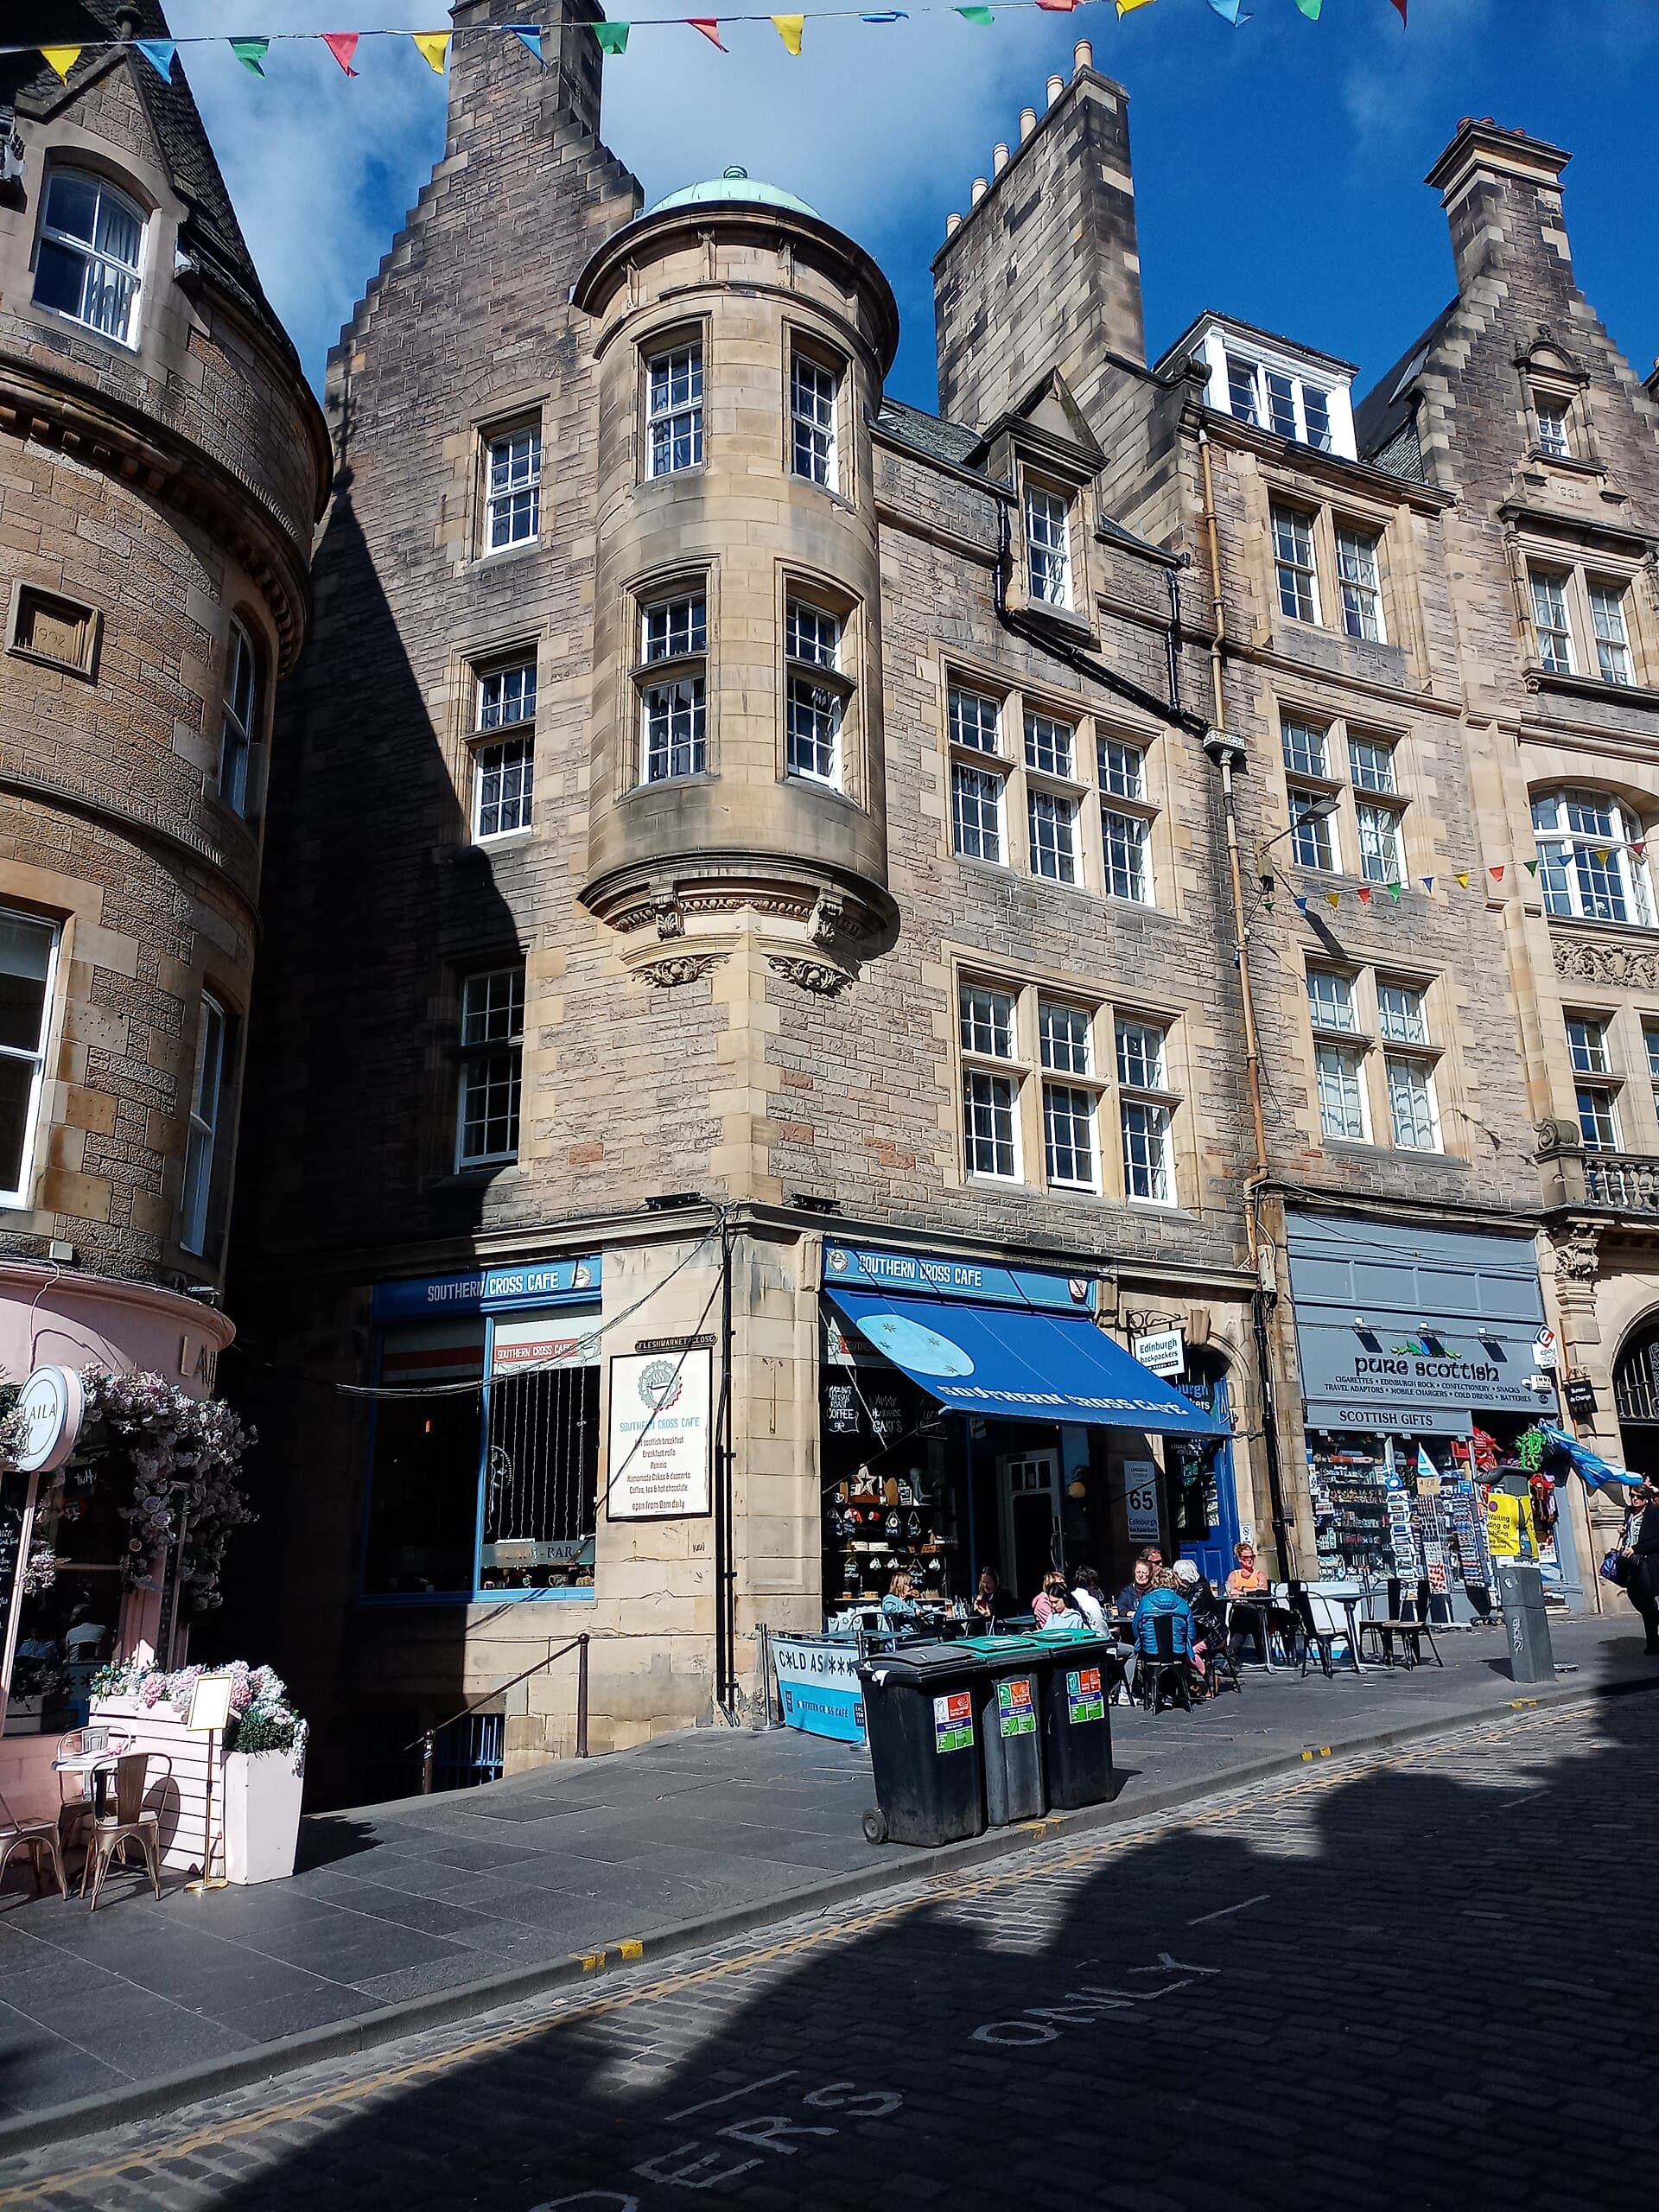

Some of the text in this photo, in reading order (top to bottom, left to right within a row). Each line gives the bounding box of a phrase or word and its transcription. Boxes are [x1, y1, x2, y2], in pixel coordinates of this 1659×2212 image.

[858, 1255, 982, 1287] SOUTHERN CROSS CAFE
[427, 1271, 559, 1302] SOUTHERN CROSS CAFE
[639, 1335, 714, 1349] FLESHMARKET CLOSE
[1140, 1338, 1178, 1354] Edinburgh
[497, 1347, 531, 1360] SOUTHERN
[532, 1344, 552, 1356] CROSS
[1141, 1350, 1179, 1363] backpackers
[1541, 1348, 1556, 1357] epay
[1355, 1357, 1501, 1382] pure scottish
[1335, 1376, 1373, 1384] CIGARETTES
[1381, 1378, 1416, 1387] EDINBURGH
[1441, 1382, 1490, 1391] CONFECTIONERY
[936, 1385, 1071, 1405] SOUTHERN
[1065, 1394, 1137, 1410] CROSS
[1325, 1383, 1349, 1392] TRAVEL
[1350, 1385, 1384, 1394] ADAPTORS
[1391, 1387, 1414, 1395] MOBILE
[1415, 1389, 1448, 1398] CHARGERS
[1501, 1394, 1532, 1402] BATTERIES
[23, 1402, 57, 1421] LAILA
[827, 1408, 854, 1419] COFFEE
[1339, 1410, 1433, 1426] SCOTTISH GIFTS
[620, 1416, 700, 1433] SOUTHEN CROSS CAFE
[662, 1435, 684, 1446] breakfast
[642, 1448, 676, 1459] Breakfast rolls
[651, 1460, 667, 1470] Paninis
[627, 1474, 652, 1483] Homemade
[652, 1472, 665, 1481] Cakes
[671, 1471, 690, 1480] desserts
[665, 1483, 688, 1492] chocolate
[632, 1502, 645, 1511] open
[645, 1501, 658, 1510] from
[671, 1498, 685, 1510] daily
[1129, 1489, 1154, 1511] 65
[1128, 1517, 1158, 1529] Edinburgh
[1488, 1513, 1510, 1523] Waiting
[810, 1653, 823, 1673] AS
[966, 1951, 1223, 2046] ONLY
